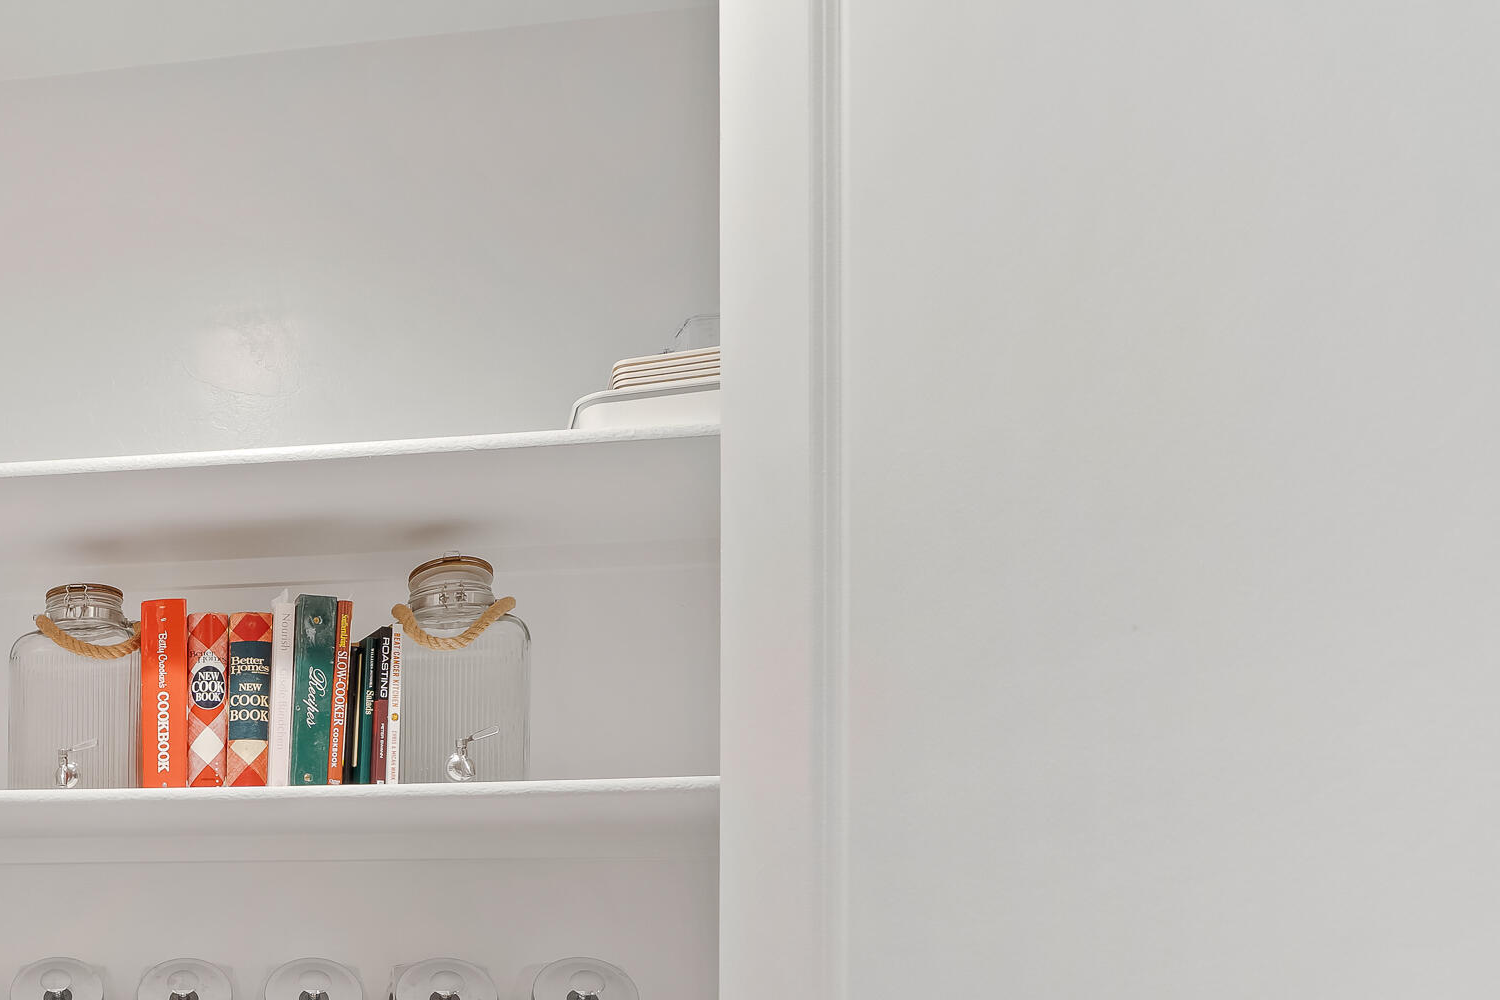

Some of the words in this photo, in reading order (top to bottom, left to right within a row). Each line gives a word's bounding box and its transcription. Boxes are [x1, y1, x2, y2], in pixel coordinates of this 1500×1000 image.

[157, 630, 167, 654] Betty
[281, 612, 292, 651] Nourish
[393, 632, 401, 649] BEAT
[231, 656, 265, 666] Better
[231, 663, 270, 675] Homes
[379, 637, 391, 699] ROASTING
[392, 650, 400, 677] CANCER
[191, 680, 225, 694] COOK
[198, 671, 220, 681] NEW
[238, 682, 263, 692] NEW
[333, 650, 348, 726] SLOW-COOKER
[195, 692, 222, 702] BOOK
[230, 694, 269, 708] COOK
[302, 665, 328, 729] Recipes
[365, 690, 375, 716] Salads
[391, 678, 400, 708] KITCHEN
[230, 709, 269, 722] BOOK
[157, 691, 170, 773] COOKBOOK
[330, 727, 340, 768] COOKBOOK
